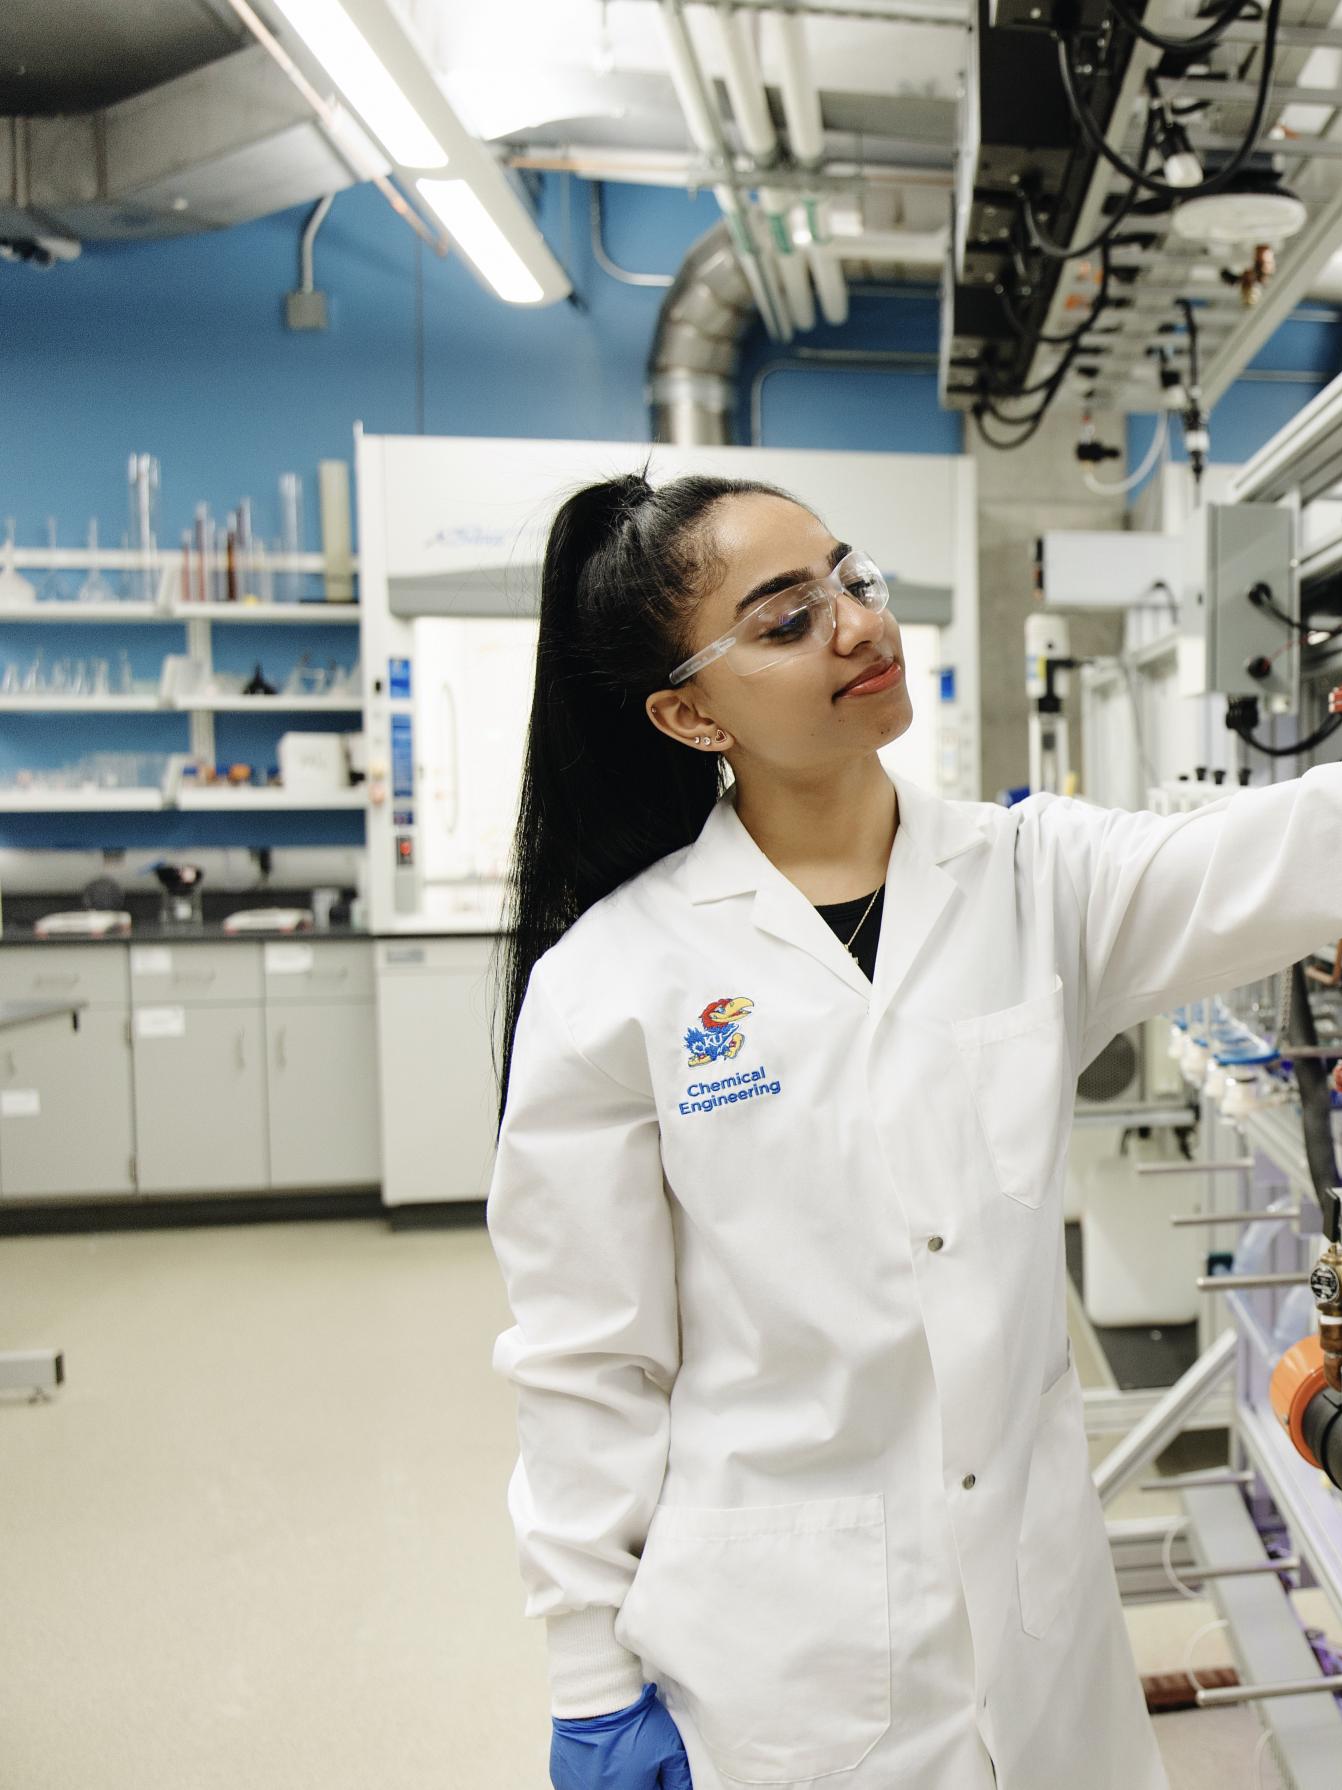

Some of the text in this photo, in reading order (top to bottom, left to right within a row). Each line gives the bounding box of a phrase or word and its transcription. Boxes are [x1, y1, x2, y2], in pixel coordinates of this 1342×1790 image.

[704, 1033, 723, 1047] KU
[687, 1066, 766, 1097] Chemical
[679, 1080, 781, 1116] Engineering
